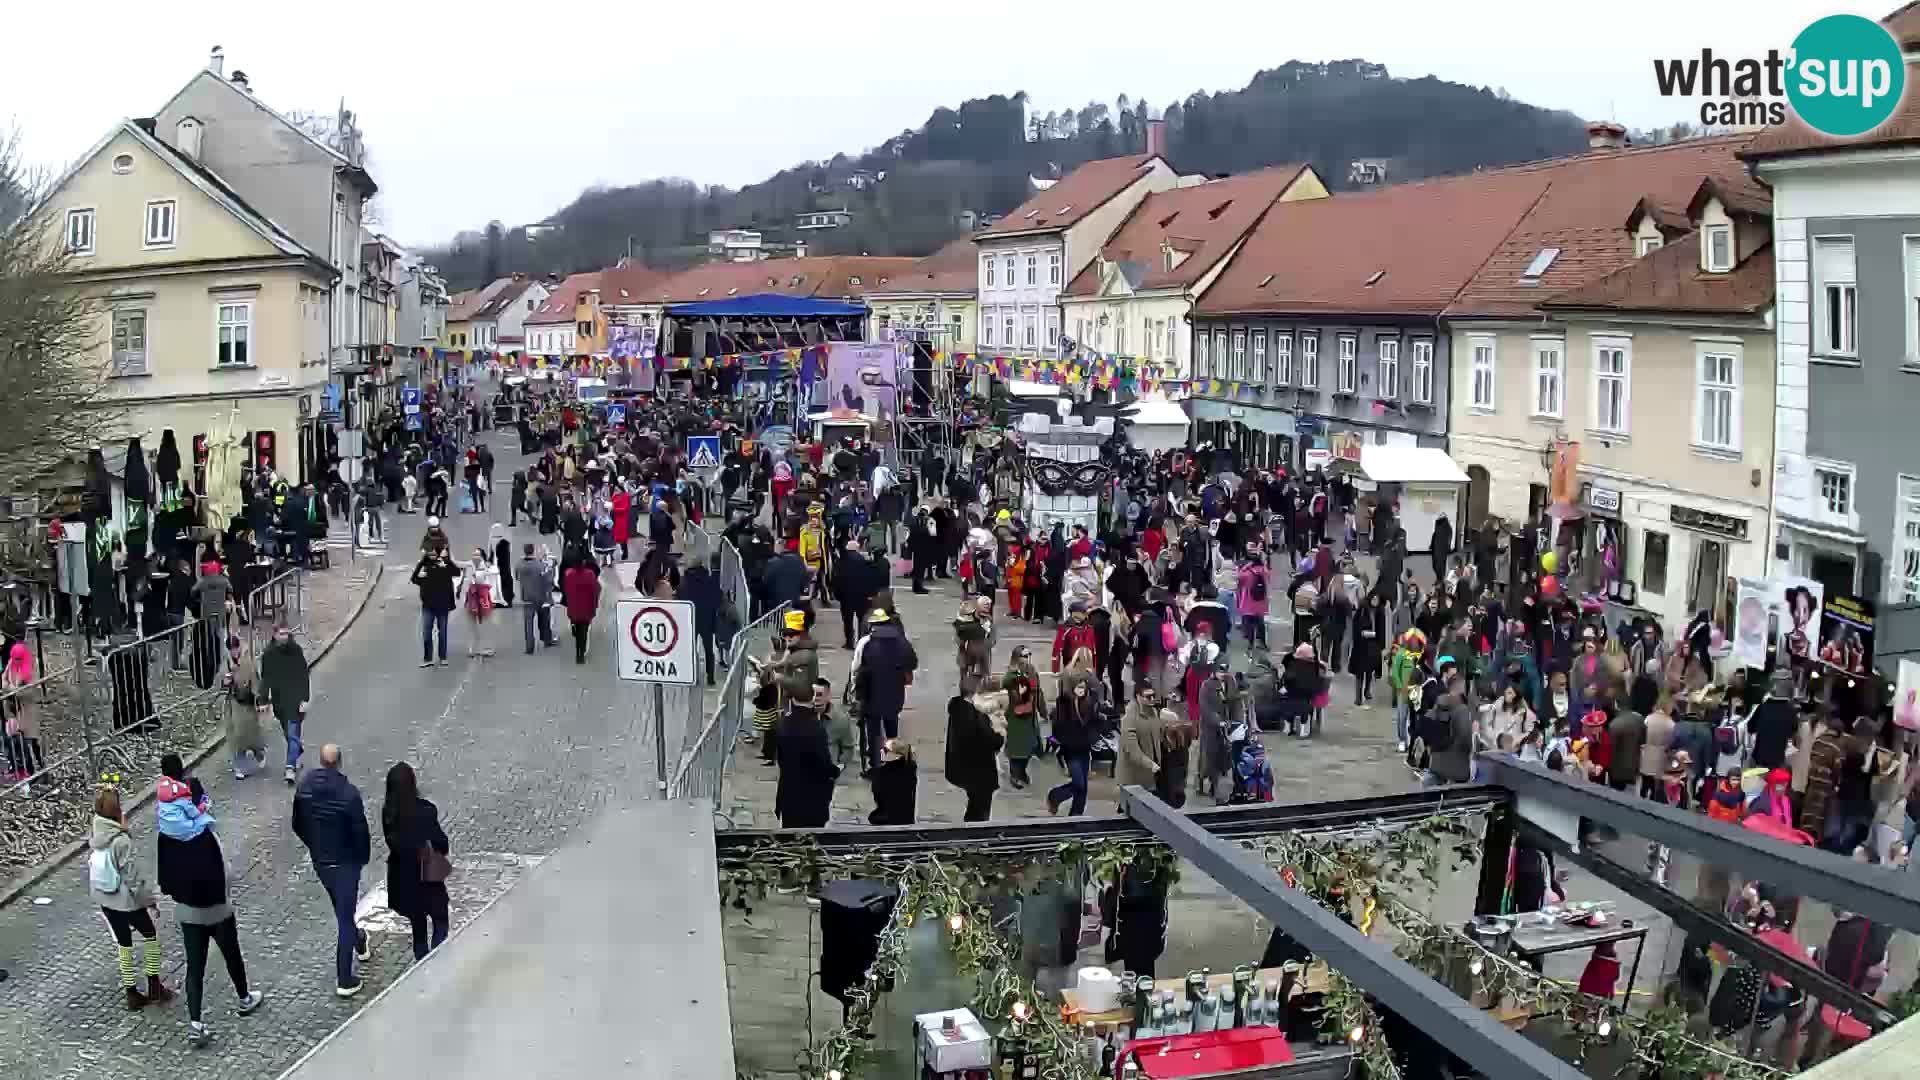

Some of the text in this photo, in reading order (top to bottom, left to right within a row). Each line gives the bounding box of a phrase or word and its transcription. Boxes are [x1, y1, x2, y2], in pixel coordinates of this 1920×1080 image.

[408, 391, 416, 403] P
[643, 622, 667, 643] 30
[633, 659, 677, 677] ZONA
